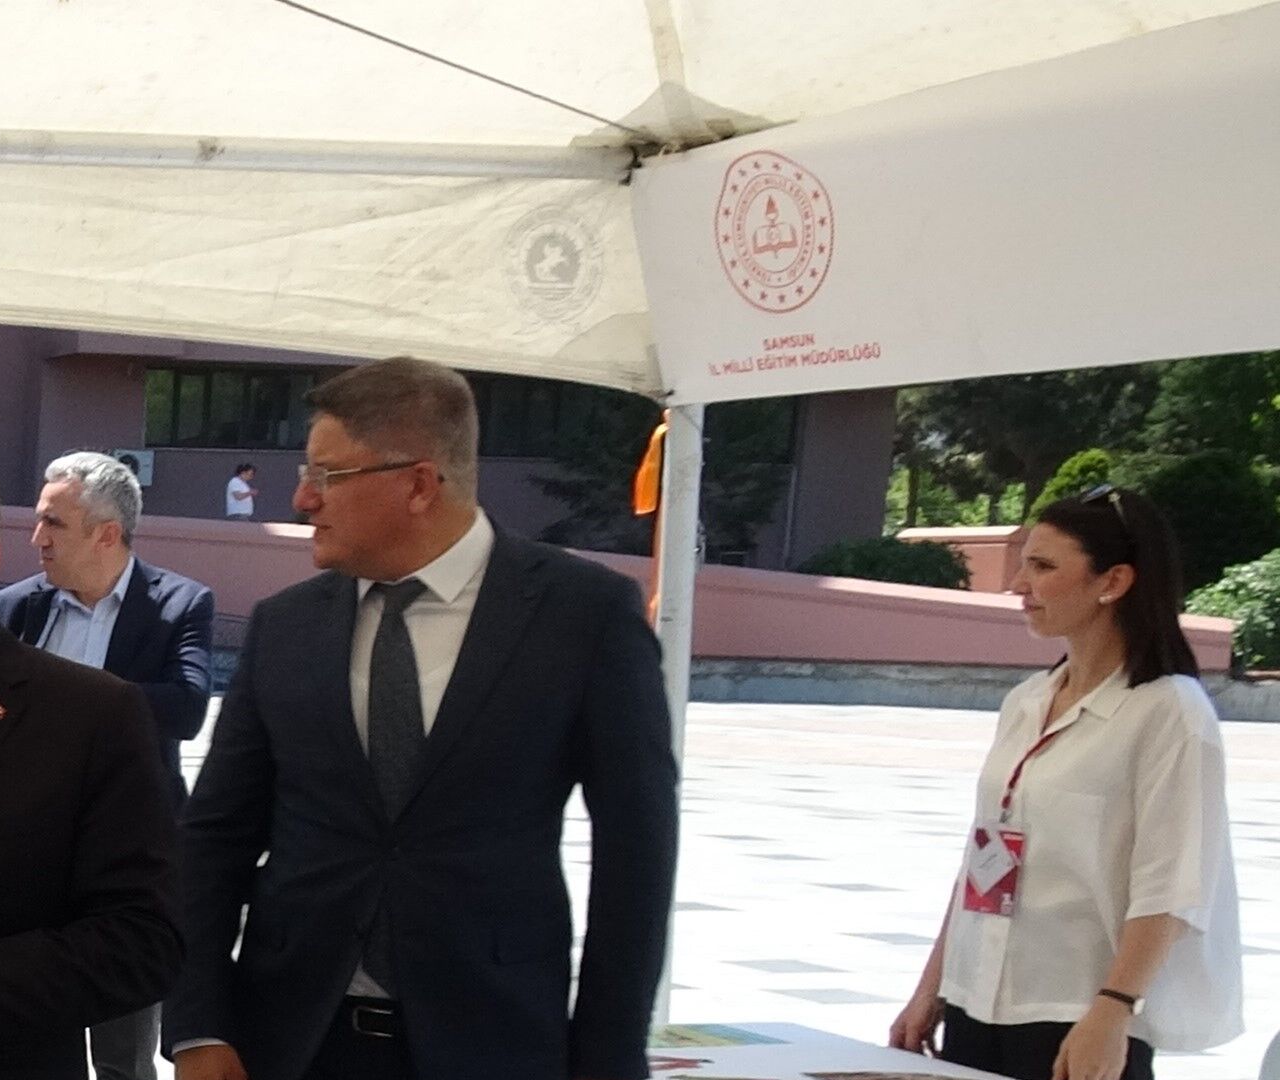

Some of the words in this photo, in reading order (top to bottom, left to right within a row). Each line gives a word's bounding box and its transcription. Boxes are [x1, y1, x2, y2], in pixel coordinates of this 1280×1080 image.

[762, 333, 815, 350] SAMSUN
[723, 356, 753, 373] MİLLİ
[756, 352, 798, 371] EĞİTİM
[801, 342, 881, 366] MÜDÜRLÜĞÜ
